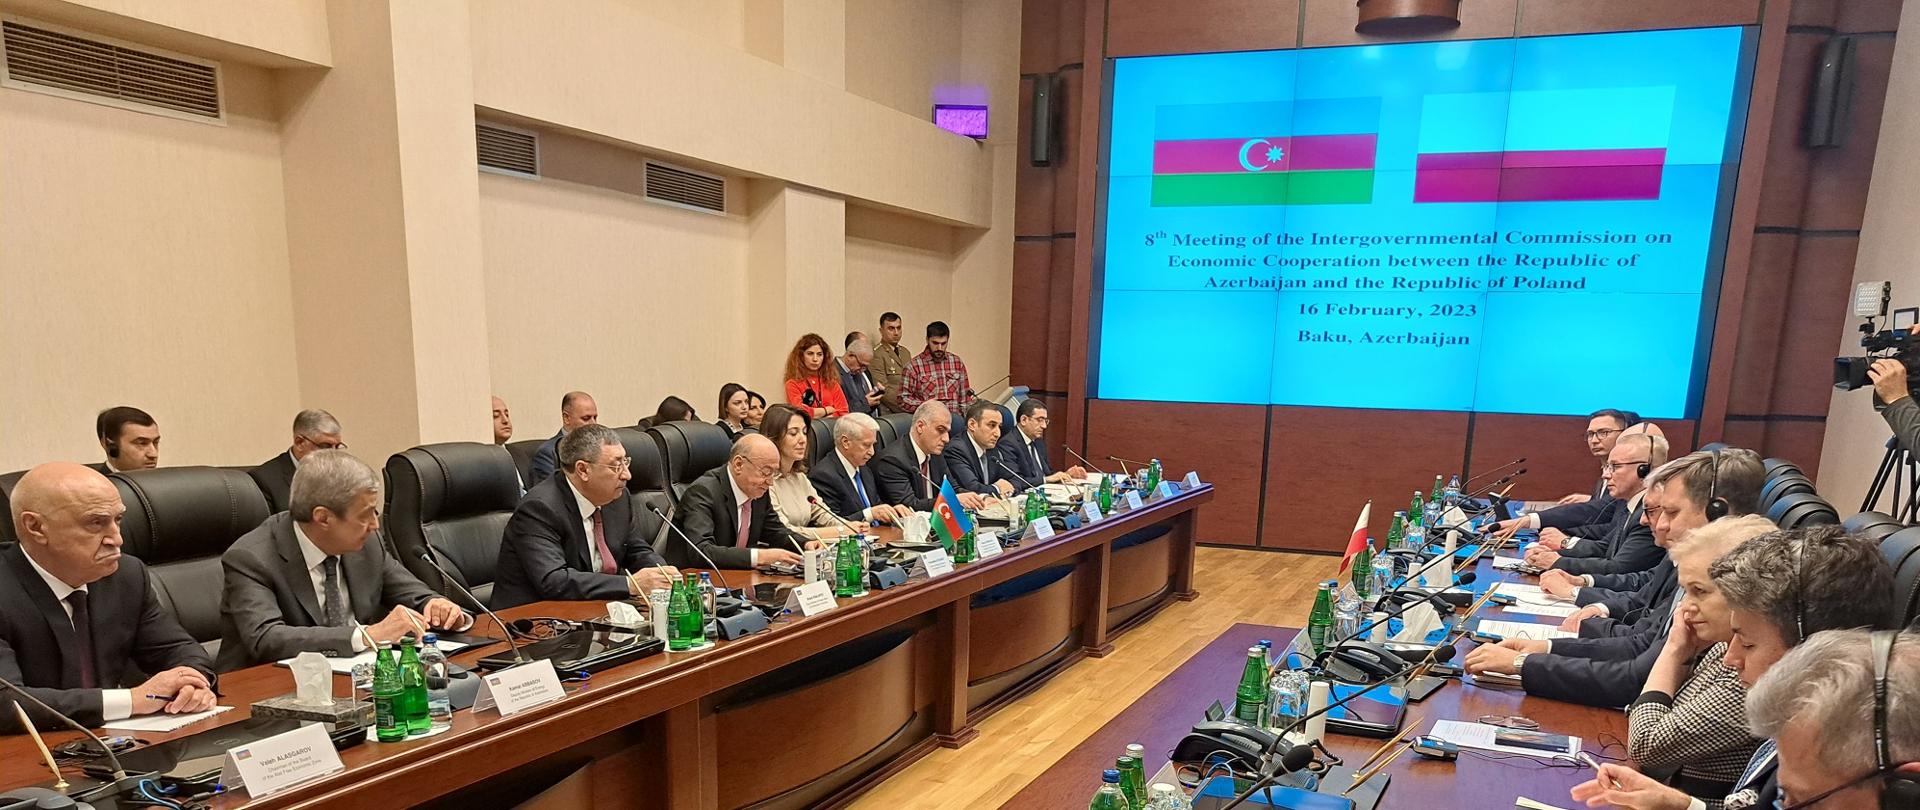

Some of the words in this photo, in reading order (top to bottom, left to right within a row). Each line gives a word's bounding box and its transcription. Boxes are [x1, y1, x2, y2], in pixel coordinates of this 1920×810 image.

[1173, 233, 1247, 248] Meeting
[1252, 232, 1272, 246] of
[1276, 232, 1305, 246] the
[1311, 231, 1498, 248] Intergovernmental
[1505, 230, 1637, 245] Commission
[1644, 233, 1673, 245] on
[1168, 255, 1257, 268] Economic
[1263, 254, 1381, 270] Cooperation
[1388, 254, 1470, 267] between
[1477, 254, 1508, 267] the
[1514, 253, 1610, 270] Republic
[1616, 253, 1641, 267] of
[1204, 276, 1307, 292] Azerbaijan
[1312, 276, 1349, 289] and
[1355, 276, 1385, 290] the
[1391, 275, 1482, 293] Republic
[1487, 275, 1508, 289] of
[1512, 275, 1587, 290] Poland
[1299, 303, 1319, 316] 16
[1325, 303, 1423, 319] February,
[1429, 303, 1477, 317] 2023
[1298, 330, 1353, 344] Baku,
[1359, 331, 1470, 348] Azerbaijan
[277, 746, 311, 761] ALASGAROV
